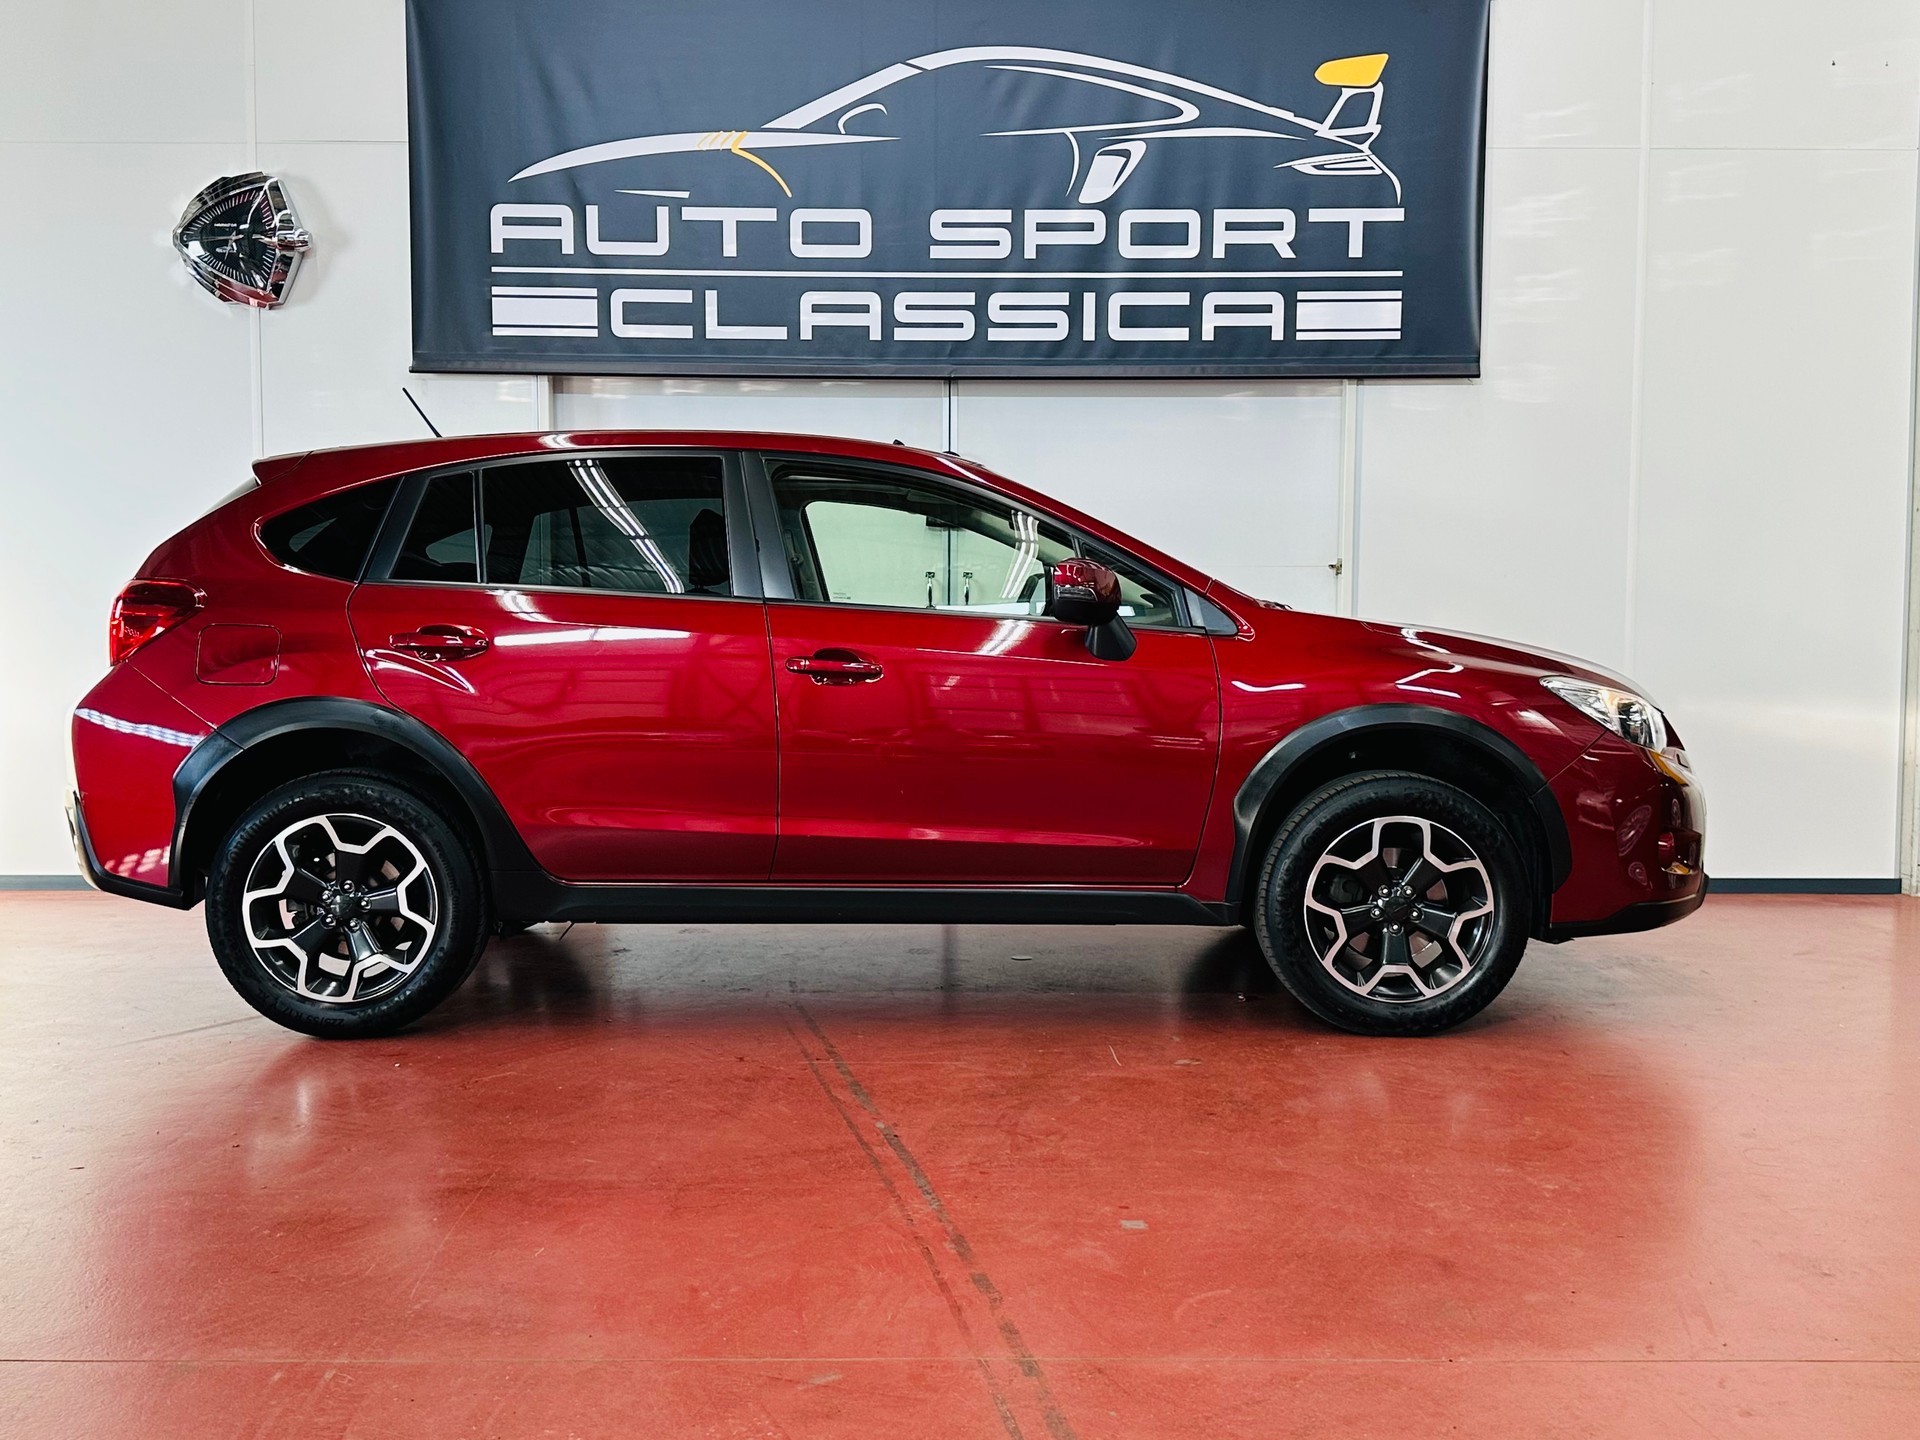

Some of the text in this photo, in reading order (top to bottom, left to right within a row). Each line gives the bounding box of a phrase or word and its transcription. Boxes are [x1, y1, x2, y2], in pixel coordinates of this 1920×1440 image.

[490, 203, 1405, 260] AUTO SPORT
[610, 288, 1285, 342] CLASSICA
